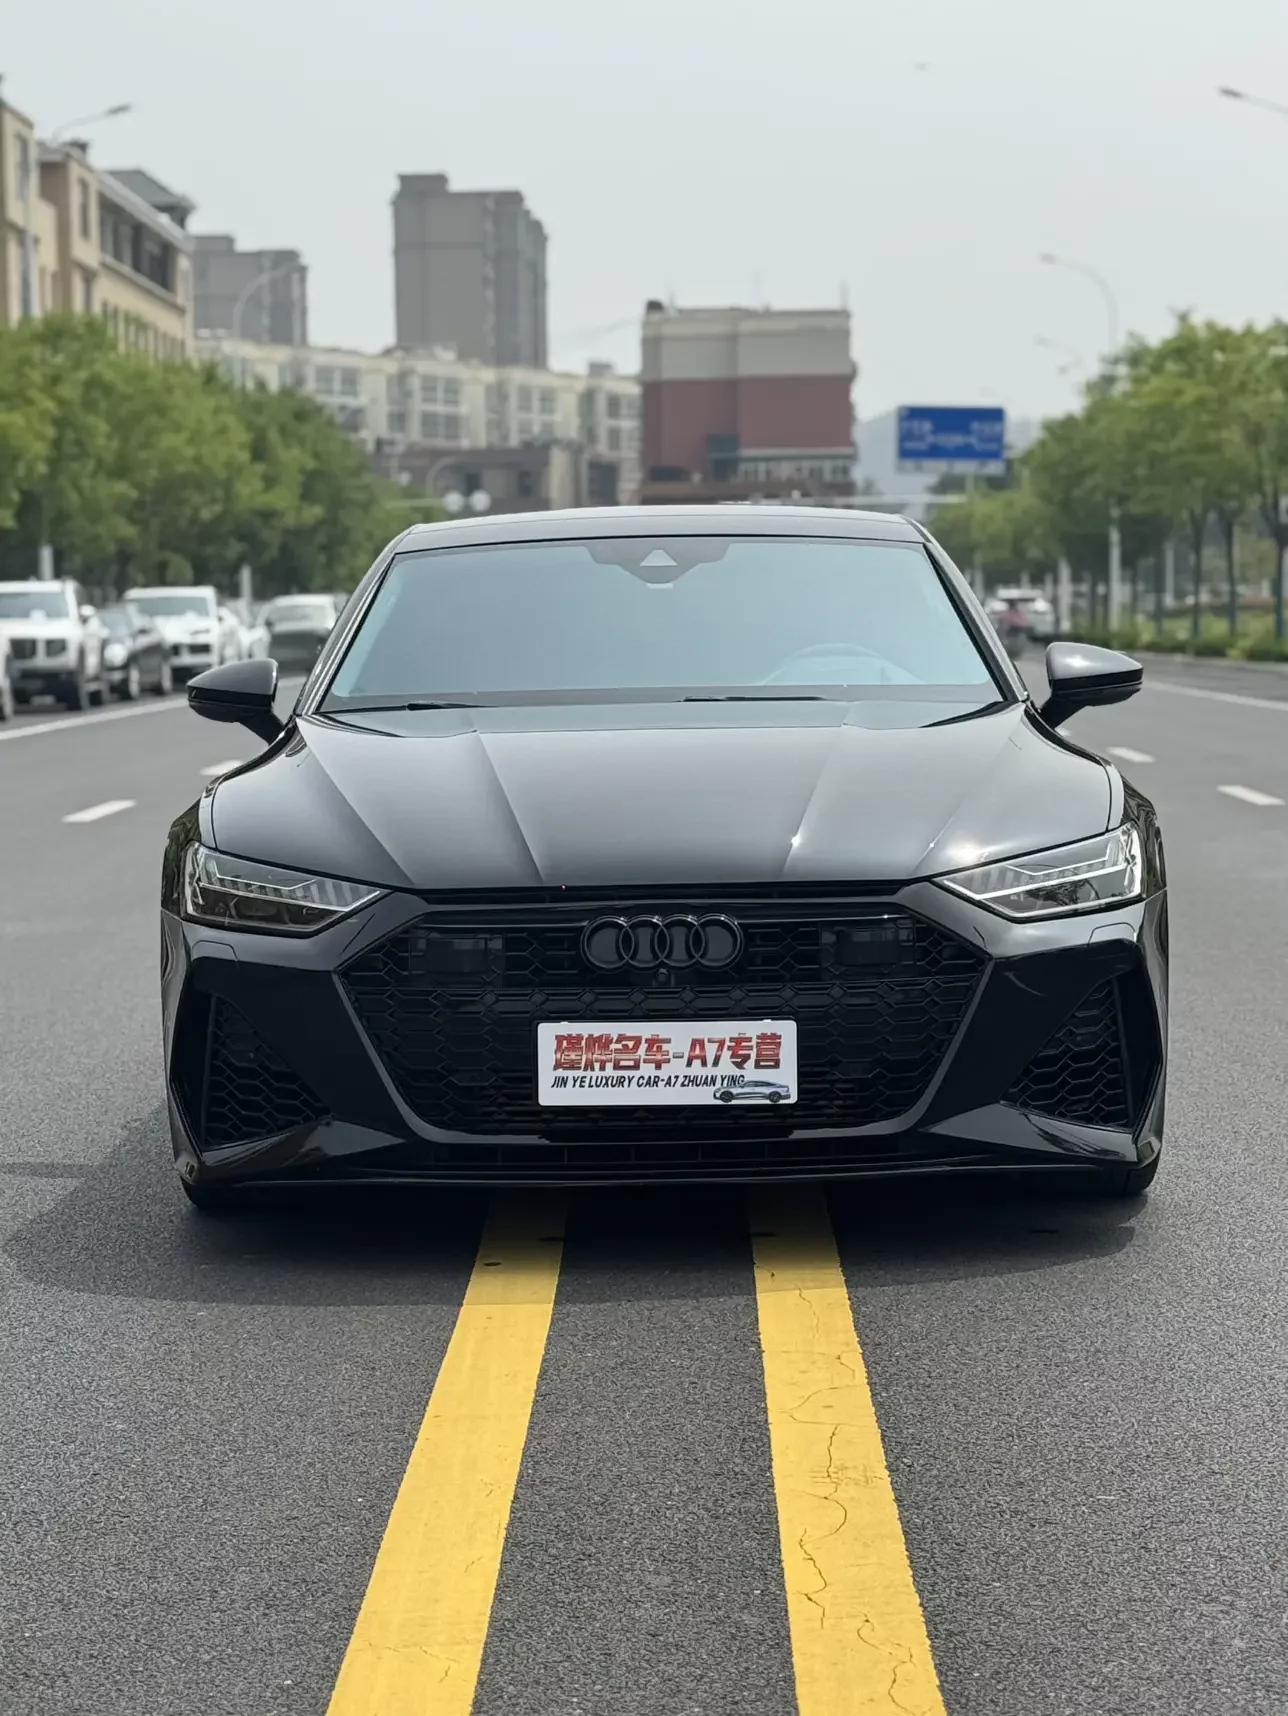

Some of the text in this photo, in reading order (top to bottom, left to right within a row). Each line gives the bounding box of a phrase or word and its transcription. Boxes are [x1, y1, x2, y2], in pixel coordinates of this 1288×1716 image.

[551, 1075, 568, 1088] JIN
[572, 1075, 586, 1088] YE
[588, 1075, 635, 1088] LUXURY
[636, 1075, 679, 1088] CAR-A7
[680, 1074, 718, 1088] ZHUAN
